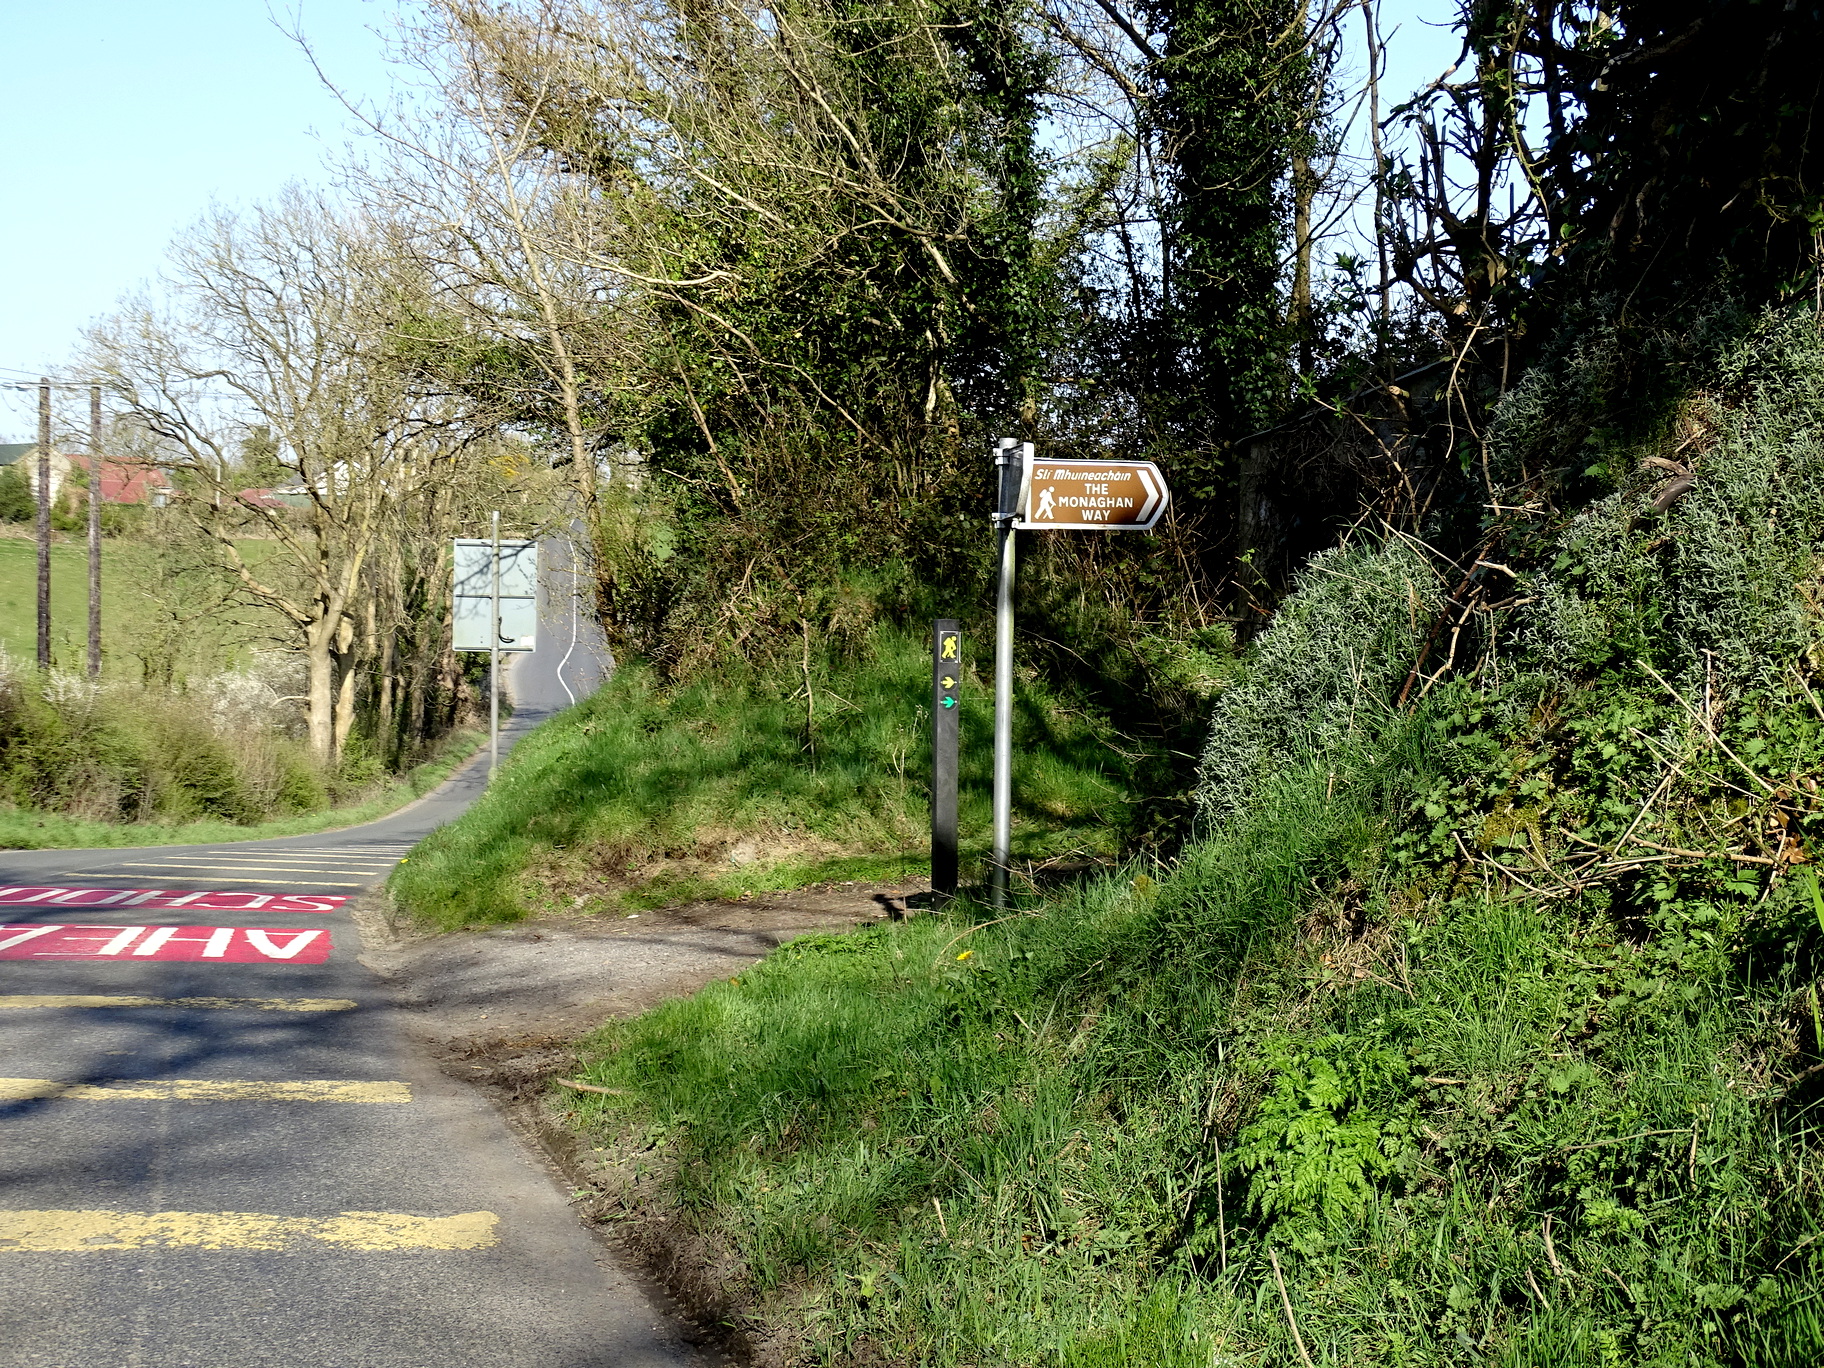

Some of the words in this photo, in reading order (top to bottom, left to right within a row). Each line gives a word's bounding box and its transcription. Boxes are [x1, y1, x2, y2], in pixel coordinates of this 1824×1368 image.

[1084, 483, 1108, 494] THE
[1058, 496, 1133, 508] MONAGHAN
[1081, 509, 1111, 520] WAY
